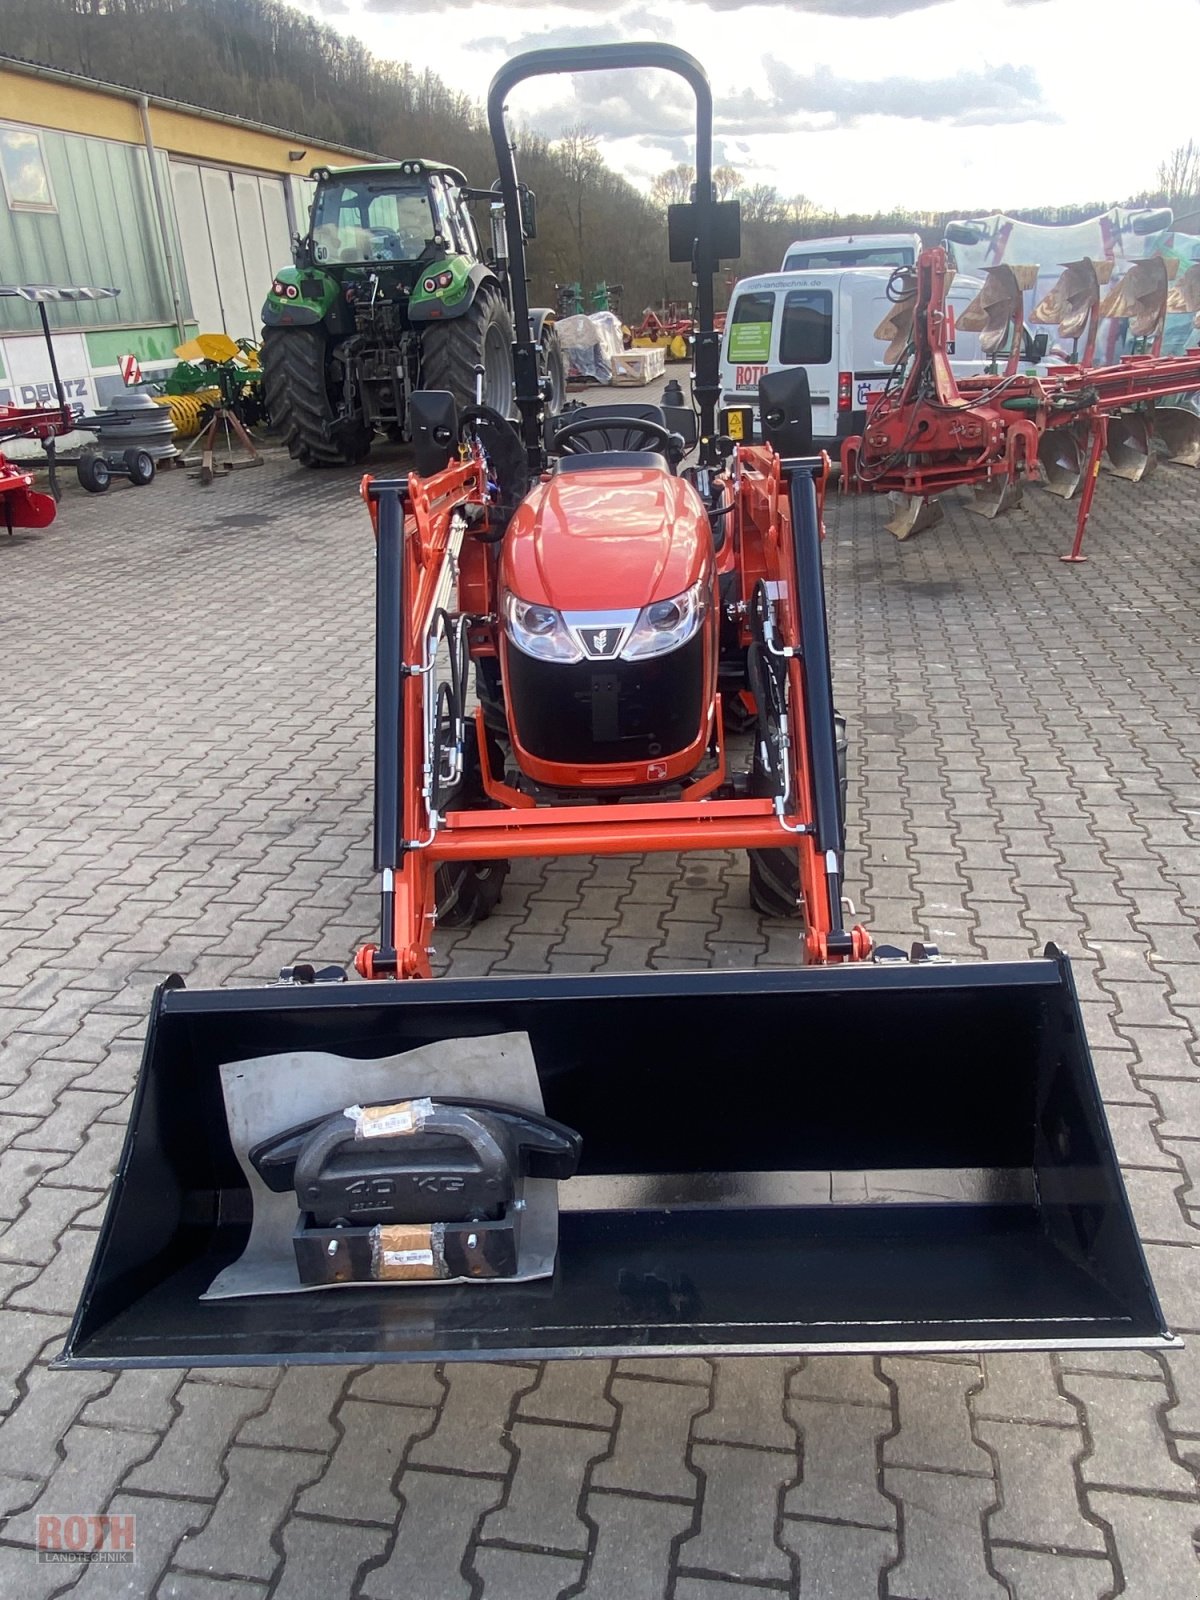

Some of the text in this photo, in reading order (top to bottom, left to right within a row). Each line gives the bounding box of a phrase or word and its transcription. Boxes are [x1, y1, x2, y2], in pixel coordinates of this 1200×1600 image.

[317, 247, 328, 260] 50
[20, 378, 88, 405] DEUTZ
[411, 1175, 466, 1194] KG
